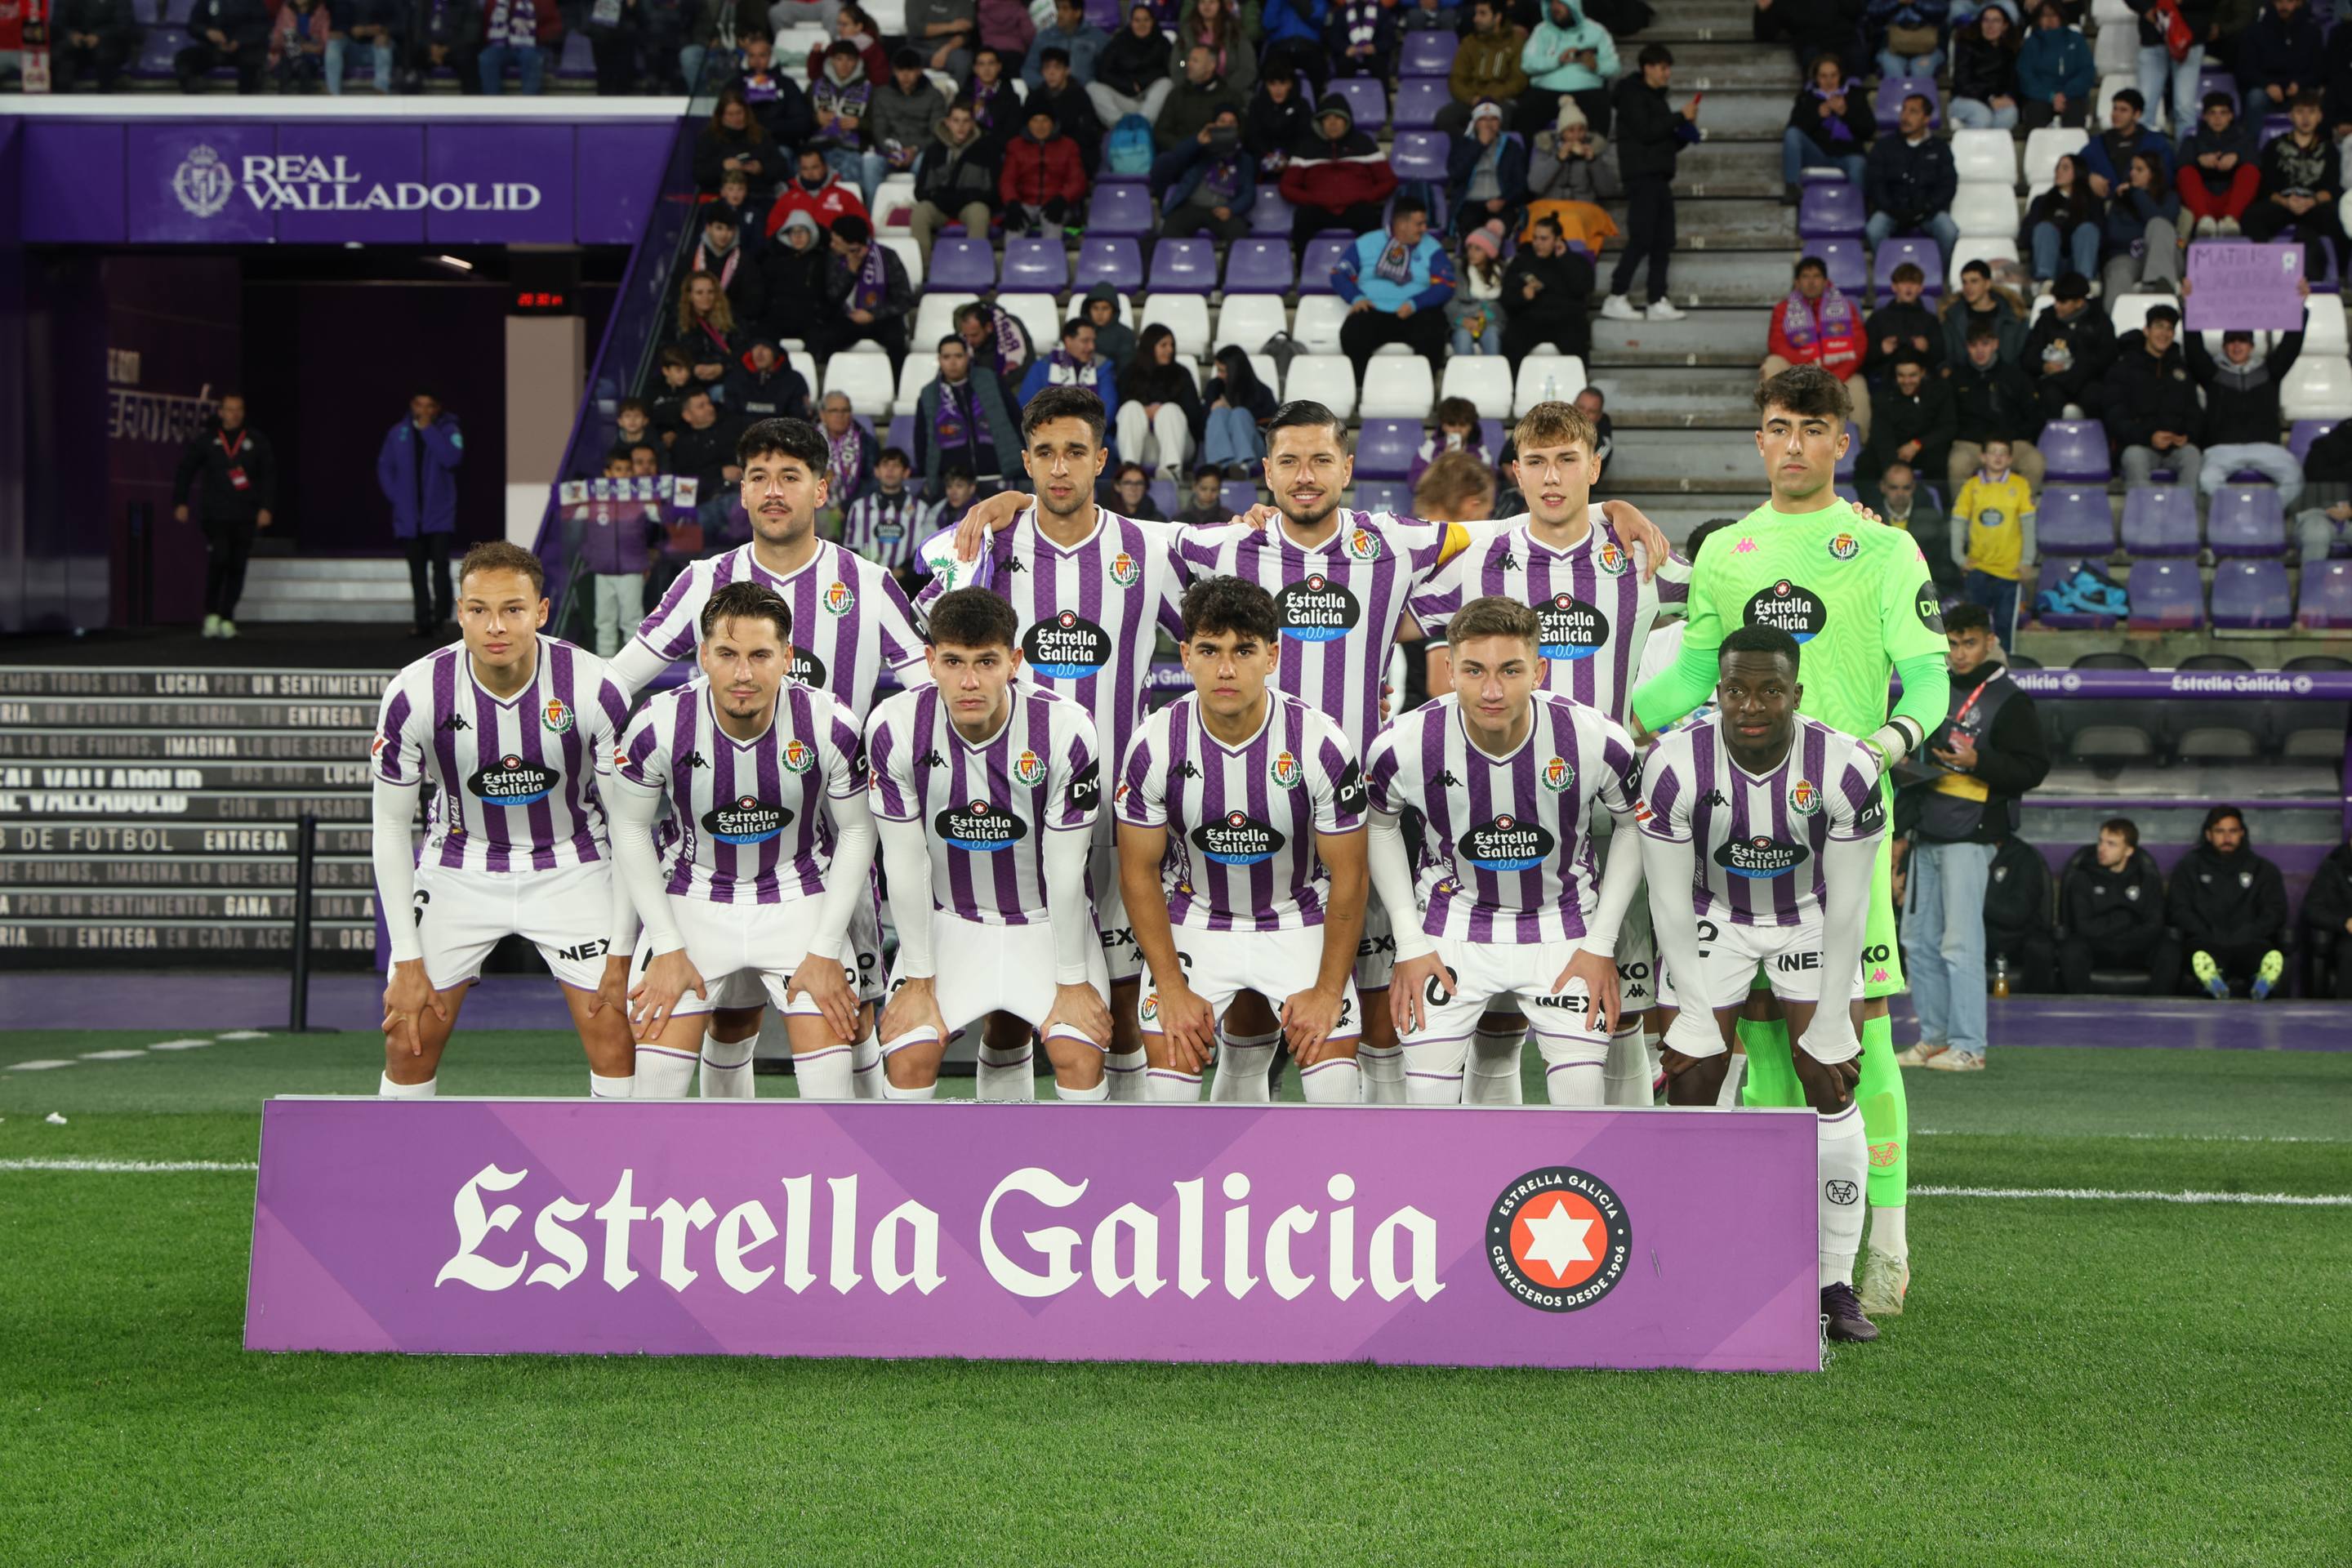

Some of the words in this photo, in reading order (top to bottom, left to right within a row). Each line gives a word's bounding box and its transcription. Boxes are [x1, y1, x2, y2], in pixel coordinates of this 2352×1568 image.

[242, 155, 360, 182] REAL
[243, 182, 541, 211] VALLADOLID
[1285, 591, 1346, 609] Estrella
[1754, 598, 1811, 617] Estrella
[1287, 607, 1343, 625] Galicia
[1036, 627, 1098, 646] Estrella
[1038, 644, 1095, 662] Galicia
[51, 674, 101, 693] TODOS
[155, 674, 208, 693] LUCHA
[214, 675, 245, 693] POR
[252, 675, 274, 694] UN
[2172, 675, 2232, 691] Estrella
[2234, 675, 2290, 692] Galicia
[46, 704, 67, 724] UN
[77, 705, 140, 724] FUTURO
[149, 705, 169, 724] DE
[260, 706, 281, 725] TU
[287, 706, 363, 726] ENTREGA
[22, 737, 42, 755] LO
[48, 737, 80, 757] QUE
[165, 737, 237, 757] IMAGINA
[245, 737, 264, 757] LO
[270, 737, 302, 759] QUE
[483, 769, 546, 786] Estrella
[486, 783, 544, 797] Galicia
[275, 799, 297, 817] UN
[303, 799, 365, 817] PASADO
[717, 809, 779, 824] Estrella
[719, 821, 777, 835] Galicia
[950, 814, 1012, 829] Estrella
[20, 828, 54, 851] DE
[69, 826, 174, 852] FÚTBOL
[204, 830, 288, 851] ENTREGA
[952, 826, 1009, 840] Galicia
[1205, 827, 1269, 843] Estrella
[1474, 831, 1538, 845] Estrella
[1209, 840, 1267, 854] Galicia
[1477, 843, 1536, 858] Galicia
[1730, 843, 1794, 859] Estrella
[1732, 854, 1791, 869] Galicia
[107, 862, 182, 883] IMAGINA
[189, 863, 211, 883] LO
[218, 863, 251, 884] QUE
[18, 895, 52, 915] POR
[60, 896, 82, 915] UN
[224, 896, 271, 917] GANA
[47, 928, 68, 947] TU
[77, 928, 158, 948] ENTREGA
[166, 929, 189, 948] EN
[198, 929, 245, 948] CADA
[1499, 1173, 1563, 1217] ESTRELLA
[1568, 1174, 1619, 1220] GALICIA
[434, 1162, 947, 1297] Estrella
[979, 1166, 1446, 1303] Galicia
[1492, 1245, 1562, 1307] CERVECEROS
[1566, 1277, 1609, 1307] DESDE
[1606, 1245, 1626, 1279] 1906
